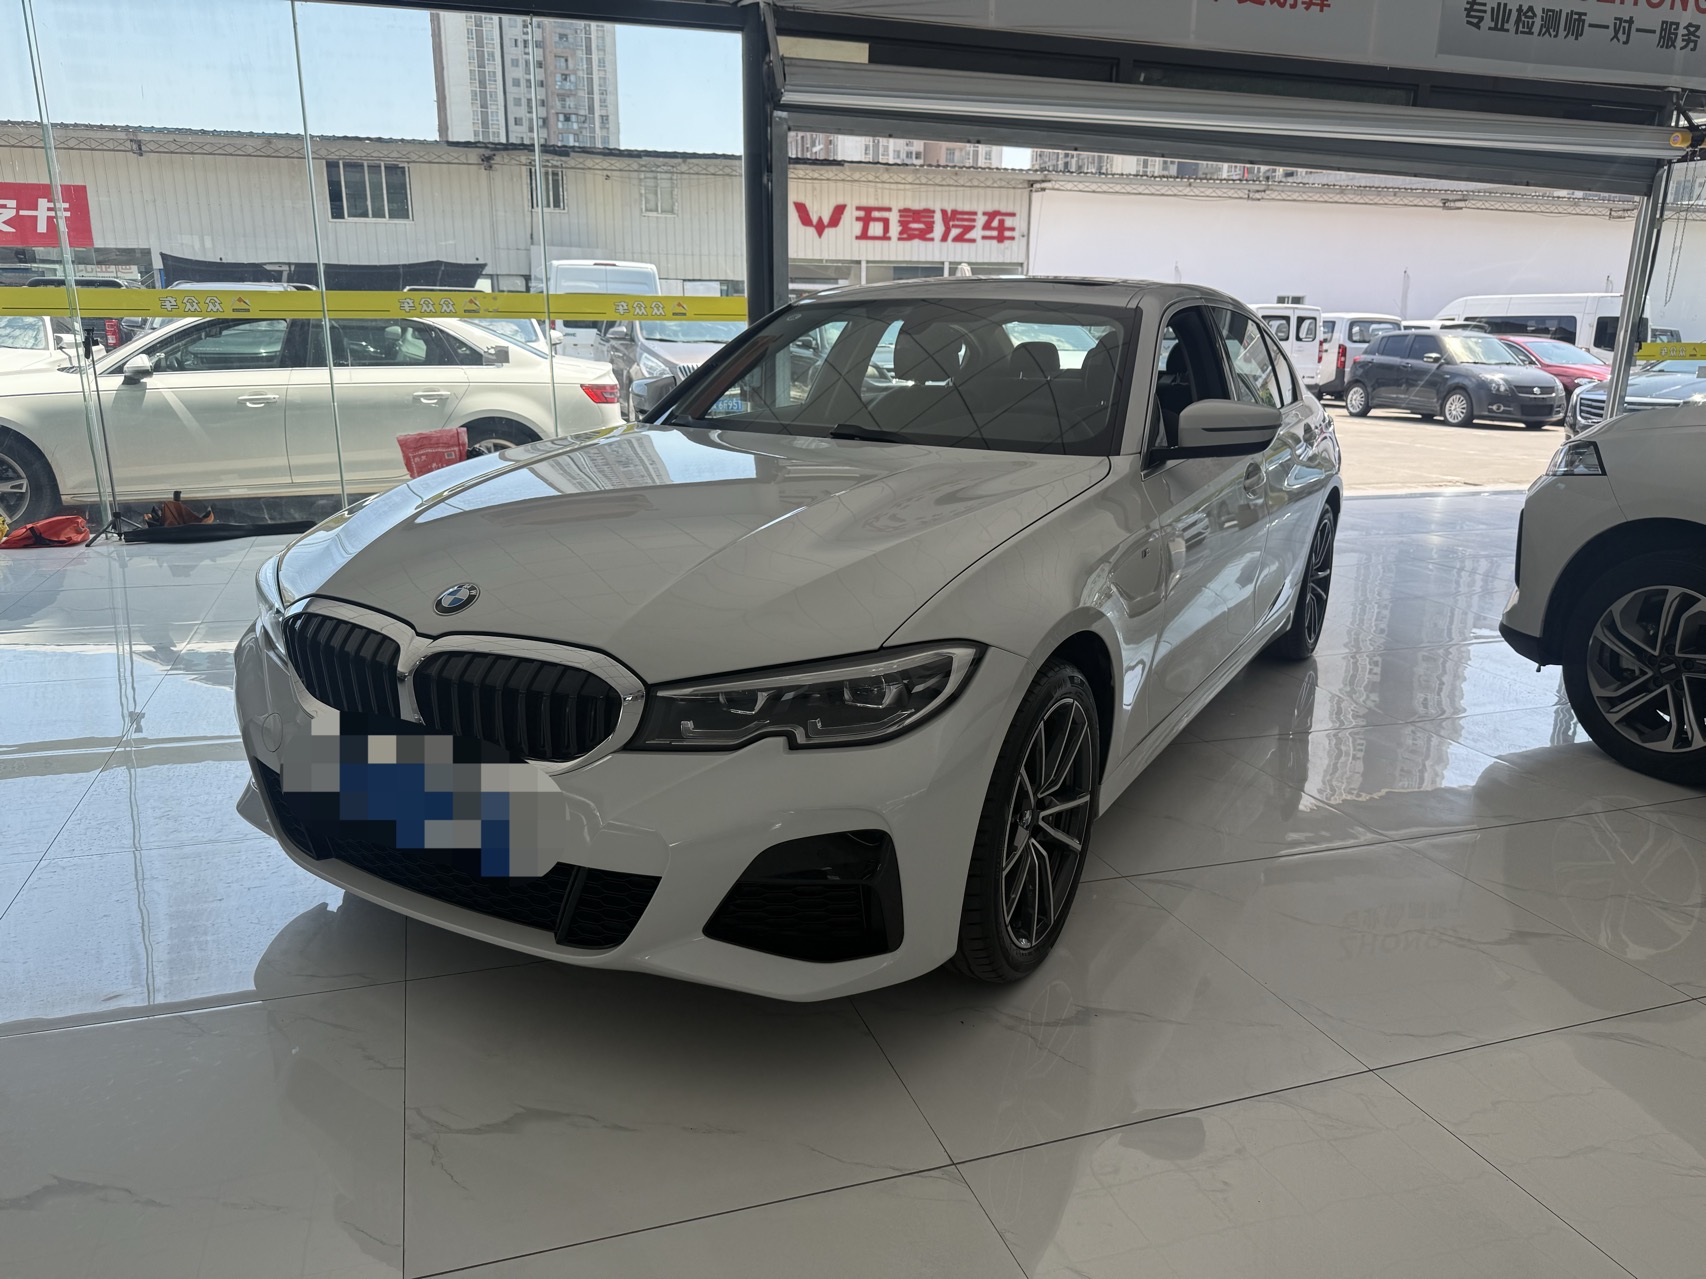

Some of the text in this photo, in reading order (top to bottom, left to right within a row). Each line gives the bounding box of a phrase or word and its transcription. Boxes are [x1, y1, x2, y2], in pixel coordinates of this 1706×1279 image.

[1464, 0, 1701, 51] 专业检测师一对一服务
[855, 206, 1016, 243] 五菱汽车
